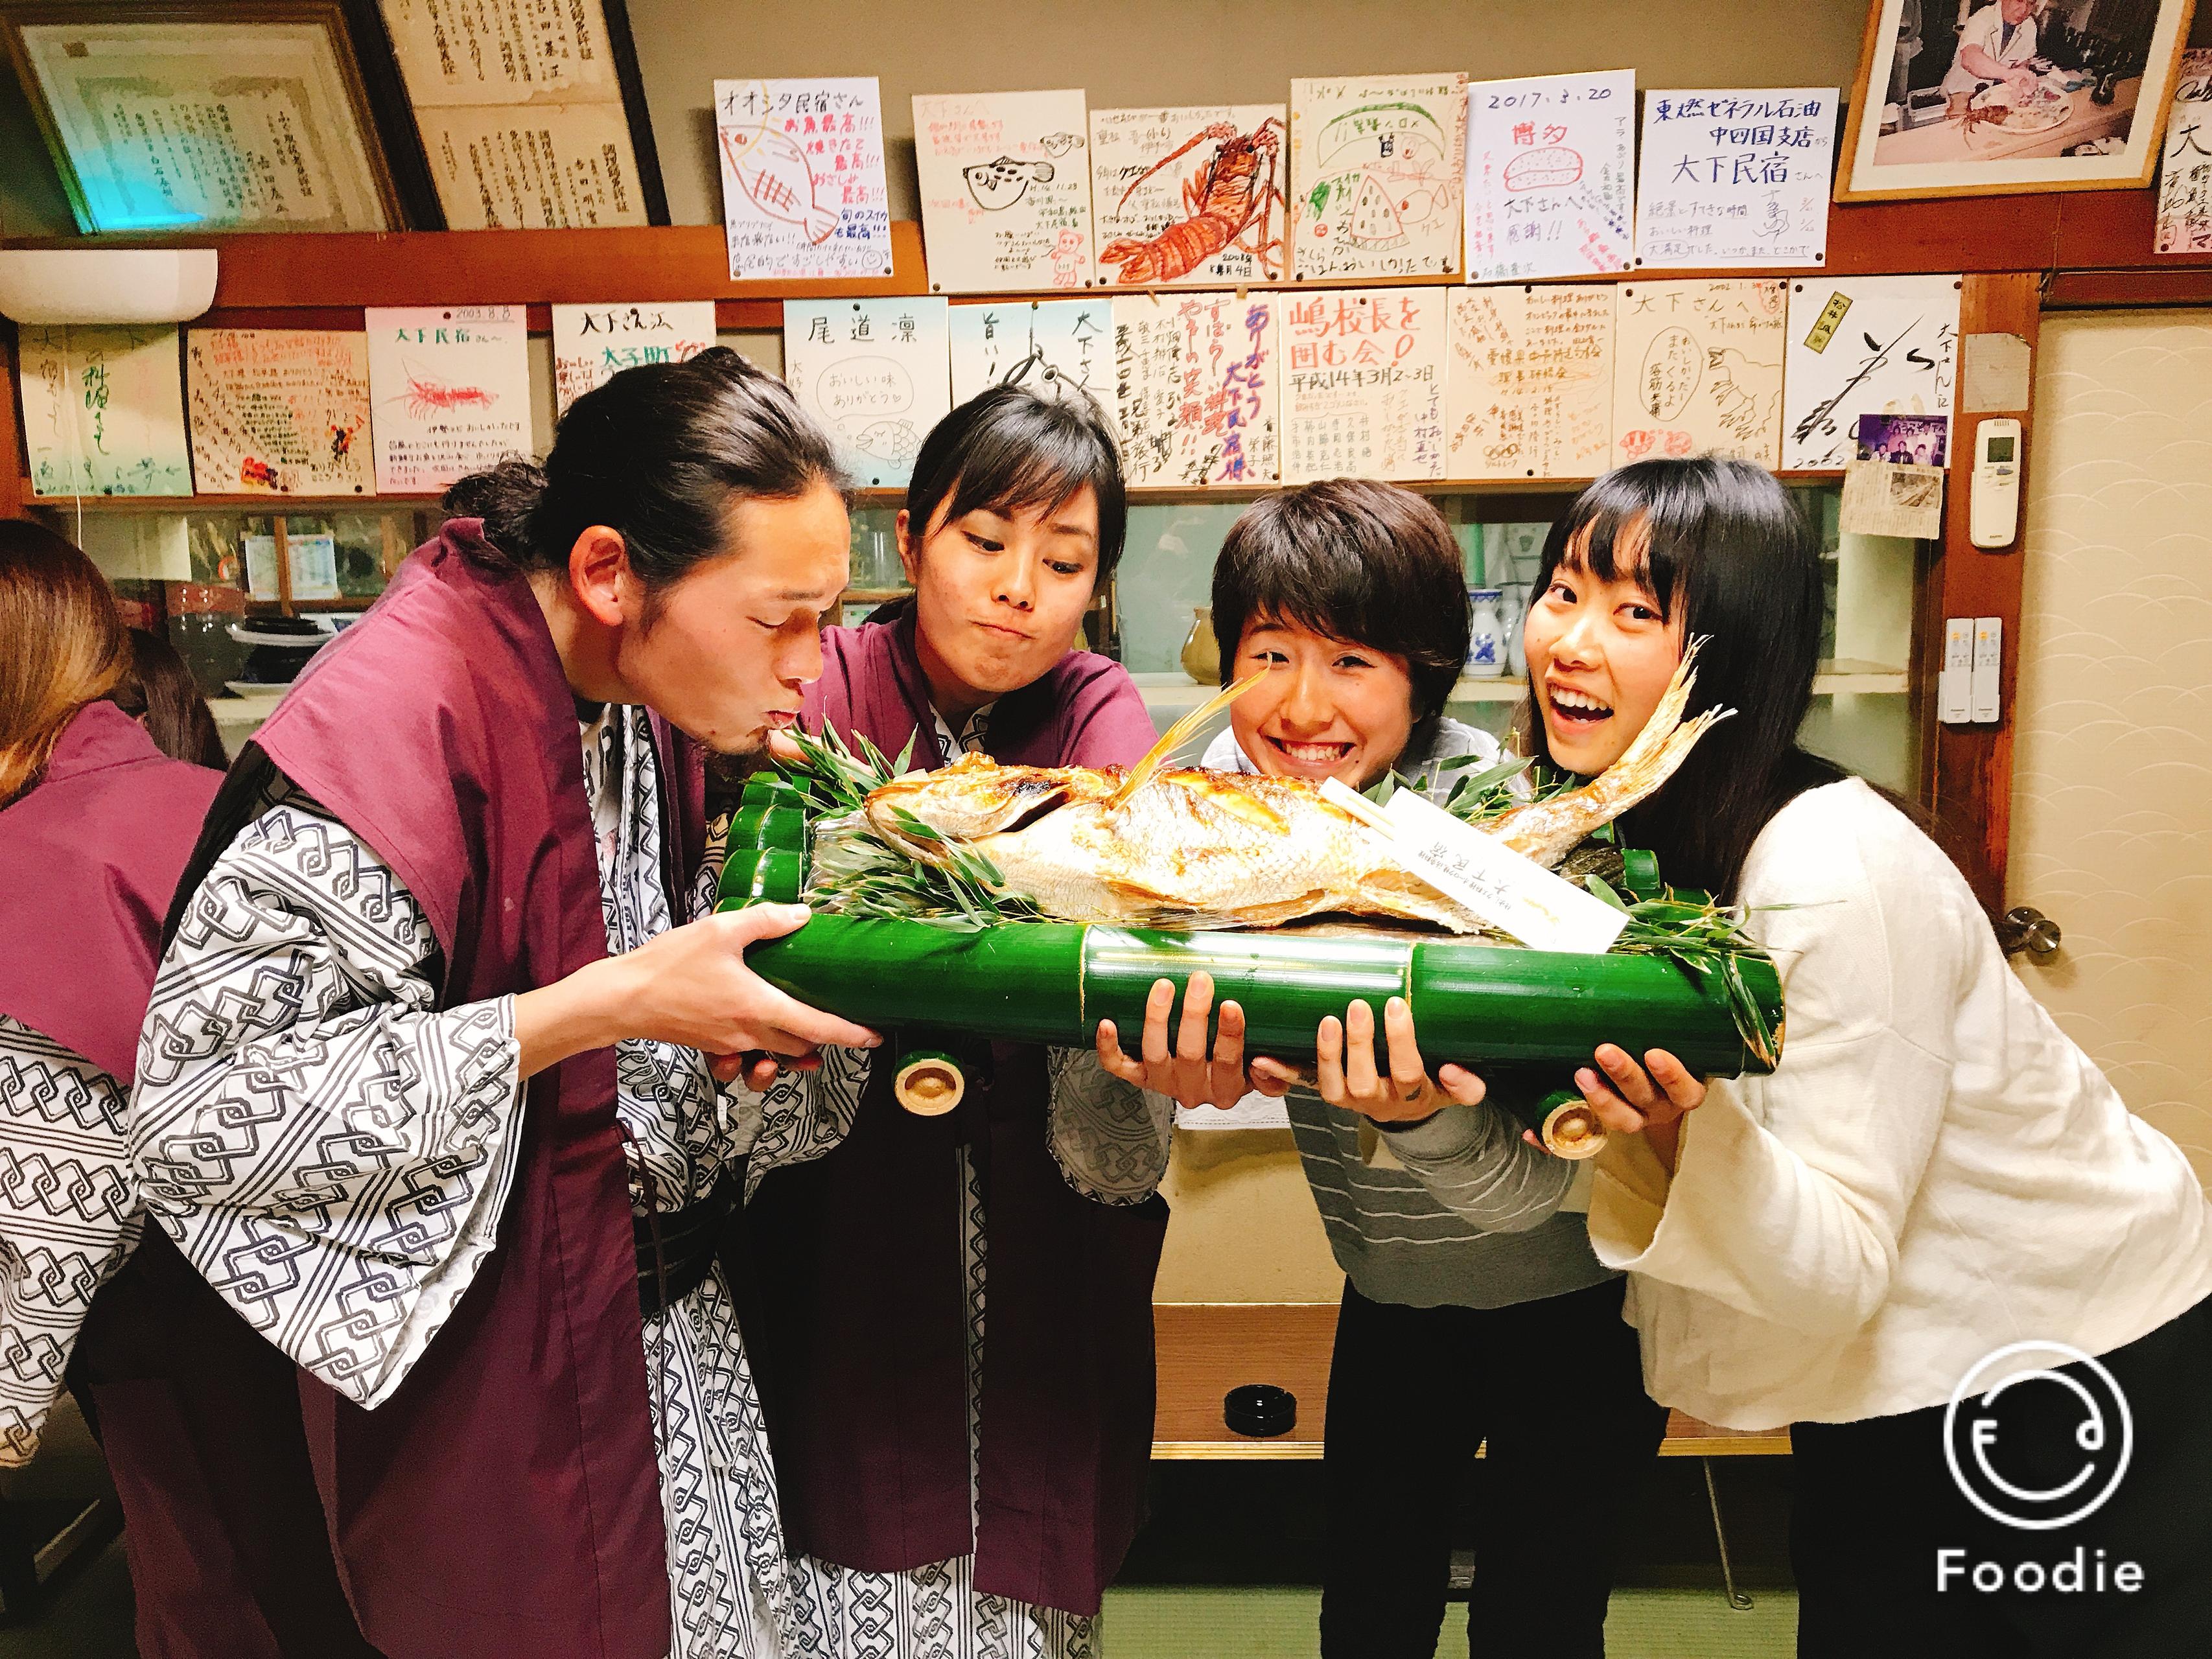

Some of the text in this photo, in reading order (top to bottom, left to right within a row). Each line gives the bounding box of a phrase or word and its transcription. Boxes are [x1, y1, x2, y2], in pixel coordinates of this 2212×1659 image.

[1654, 98, 1822, 124] 東燃ゼネラル石油
[1511, 120, 1568, 146] 博多
[1504, 196, 1583, 219] 大下さんへ
[1507, 220, 1563, 245] 感謝!!
[1631, 292, 1749, 315] 大下さんへ
[1290, 296, 1421, 338] 嶋校長を
[1245, 304, 1270, 420] ありがとう
[1664, 334, 1679, 408] またくるよ
[829, 371, 897, 388] おいしい味
[833, 392, 889, 409] ありがとう
[1417, 850, 1512, 911] 仕出し クエ料理 ホーロク焼 活魚料理
[1430, 841, 1510, 896] 大下民宿
